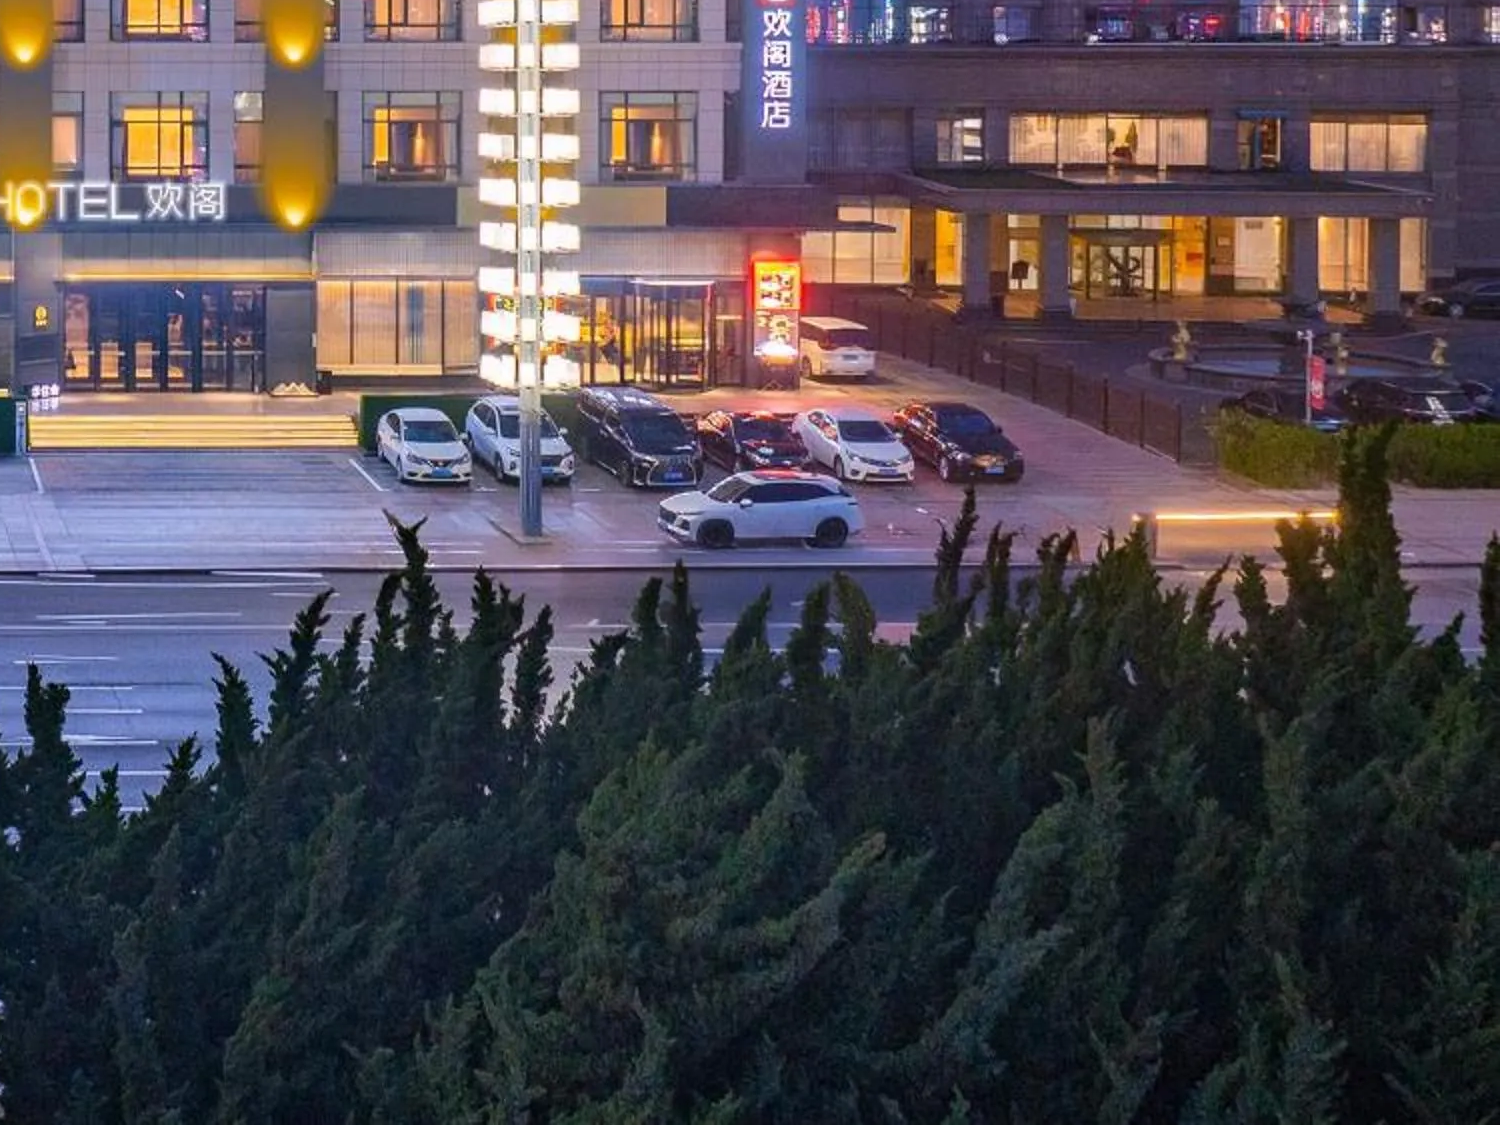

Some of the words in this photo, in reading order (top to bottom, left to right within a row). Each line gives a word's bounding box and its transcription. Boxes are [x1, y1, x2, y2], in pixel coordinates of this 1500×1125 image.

[761, 7, 792, 129] 欢阁酒店
[146, 180, 227, 221] 欢阁
